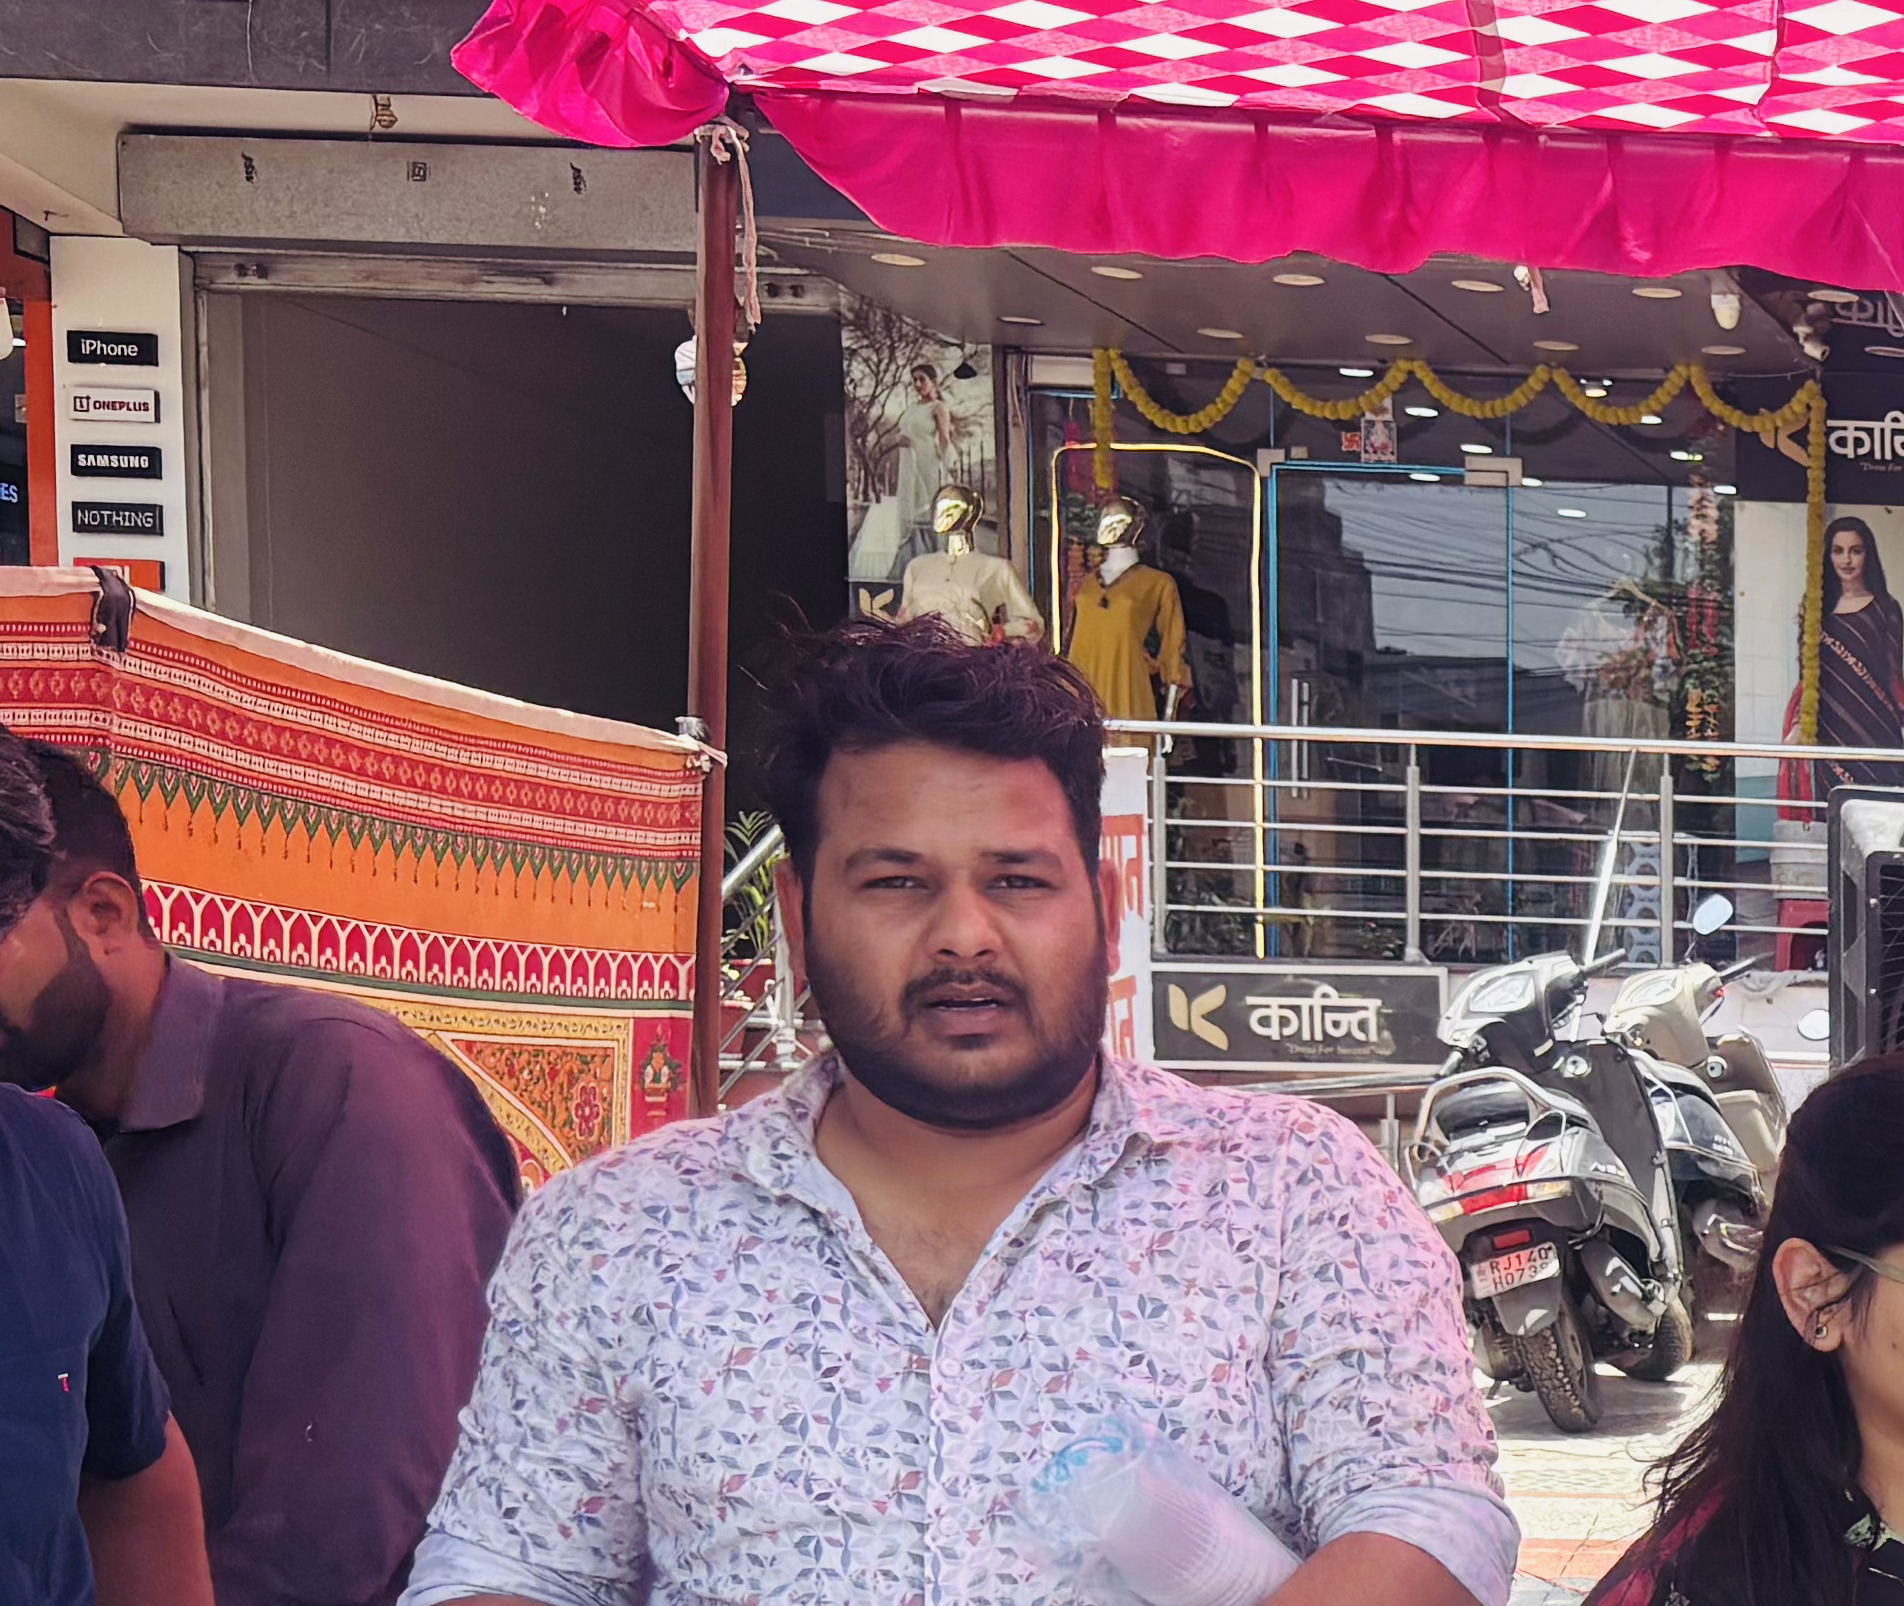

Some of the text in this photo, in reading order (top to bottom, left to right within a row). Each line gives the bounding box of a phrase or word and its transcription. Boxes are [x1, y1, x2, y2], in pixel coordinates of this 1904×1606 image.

[80, 338, 139, 357] iPhone
[93, 400, 150, 412] ONEPLUS
[77, 453, 150, 469] SAMSUNG
[77, 508, 154, 528] NOTHING
[1245, 984, 1383, 1042] कान्ति
